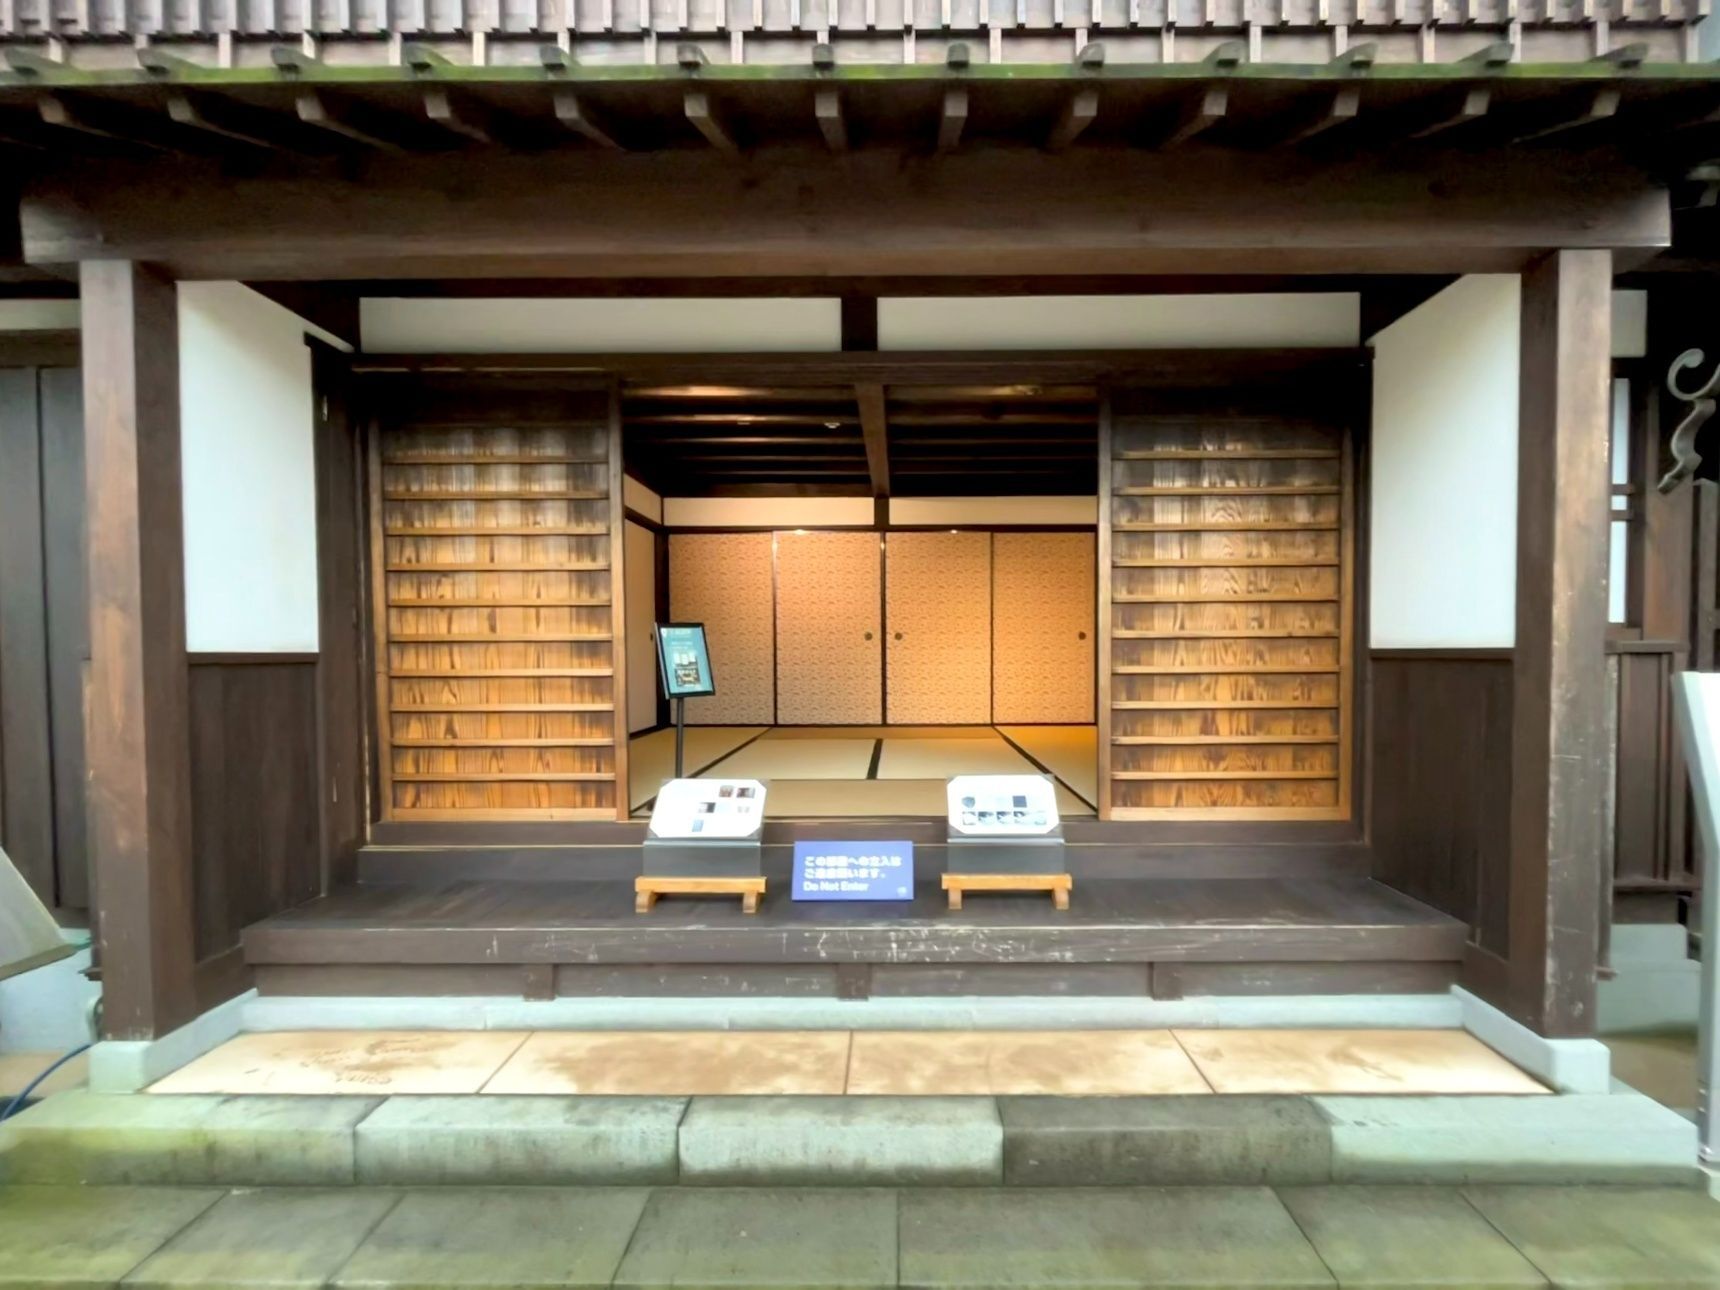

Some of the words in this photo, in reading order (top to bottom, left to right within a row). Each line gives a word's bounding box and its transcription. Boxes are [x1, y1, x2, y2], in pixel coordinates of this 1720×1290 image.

[803, 881, 818, 891] Do
[820, 881, 839, 891] Not
[841, 881, 869, 891] Enter
